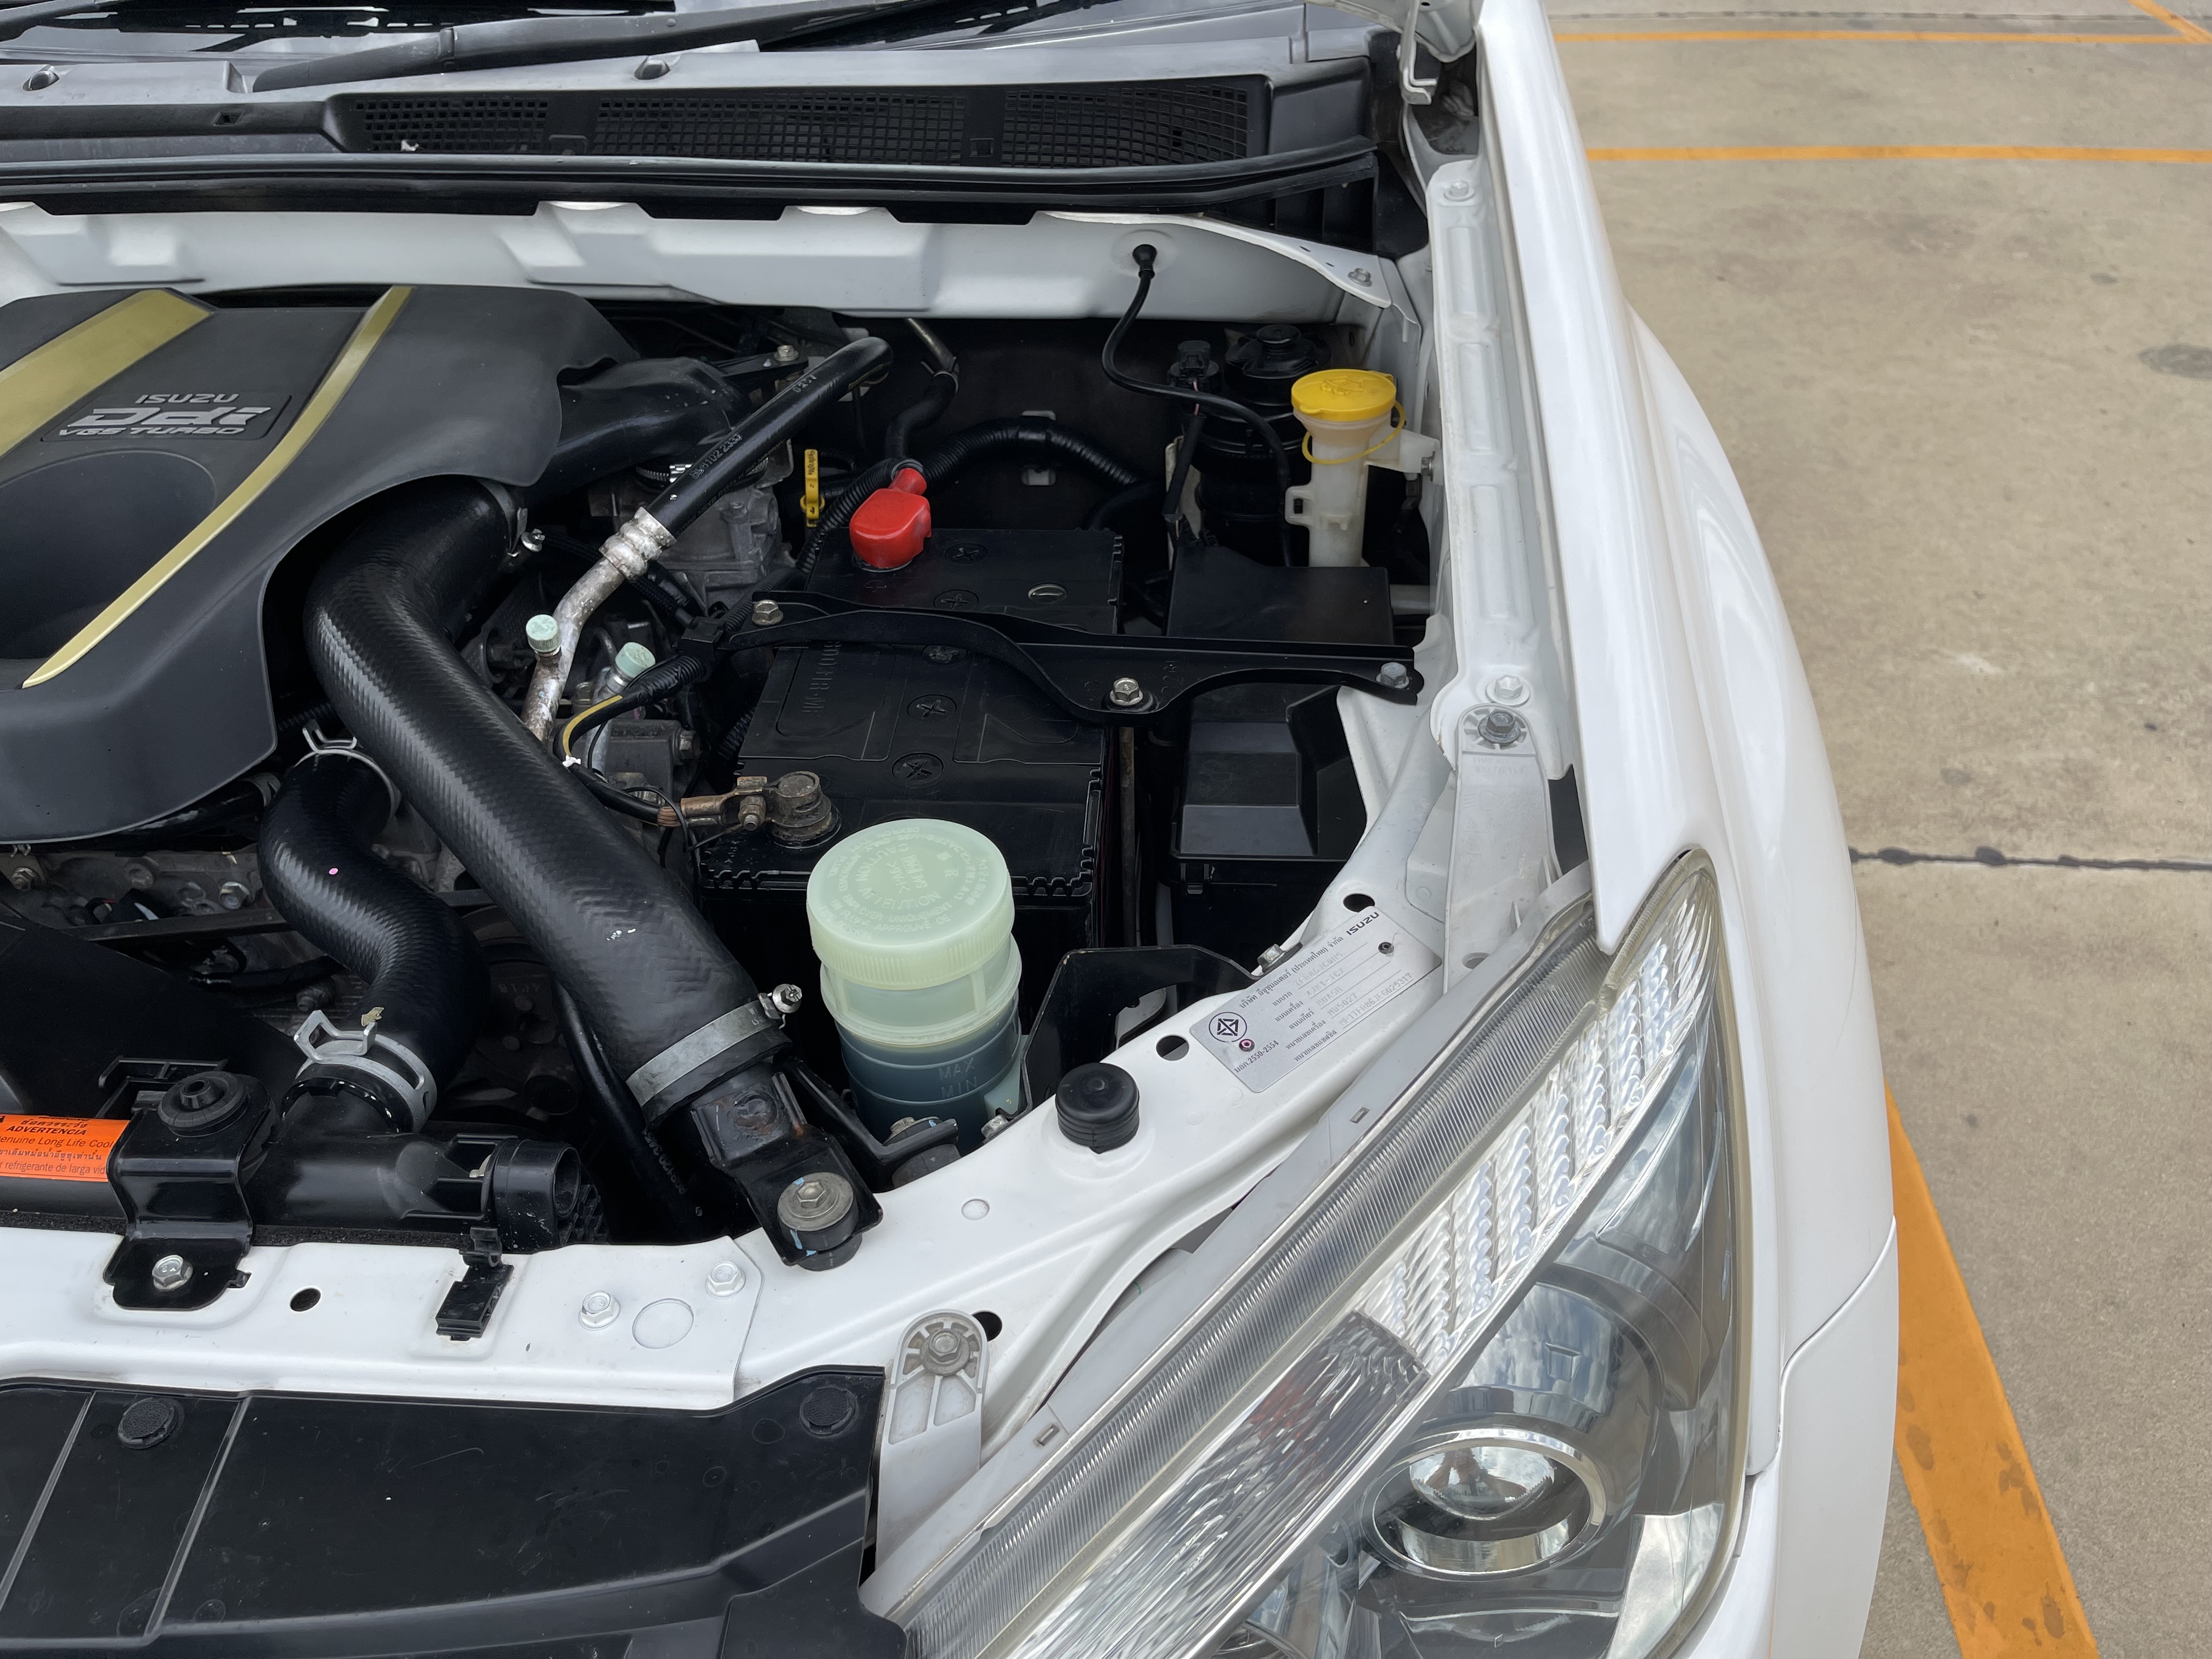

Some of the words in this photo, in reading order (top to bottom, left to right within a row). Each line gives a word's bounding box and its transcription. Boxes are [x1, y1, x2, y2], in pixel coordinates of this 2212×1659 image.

[135, 394, 239, 404] ISUZU
[59, 427, 127, 436] VGS
[130, 427, 245, 435] TURBO
[855, 843, 909, 882] CAUTION
[842, 894, 883, 921] EMPLOYER
[889, 901, 952, 922] UNIQUEMENT
[858, 887, 942, 910] ATTENTION
[935, 914, 951, 924] DE
[1346, 911, 1379, 936] ISUZU
[1239, 994, 1257, 1008] บริษัท
[1257, 969, 1291, 997] อีซูซุมอเตอร์
[1291, 947, 1329, 974] (ประเทศไทย)
[1328, 936, 1344, 949] จำกัด
[1272, 991, 1293, 1007] แบบรถ
[1275, 1000, 1304, 1022] แบบเครื่อง
[1285, 1020, 1326, 1049] หมายเลขเครื่อง
[1327, 993, 1358, 1016] MB5027
[1288, 1009, 1315, 1030] แบบเกียร์
[1234, 1040, 1279, 1073] มอก.2550-2554
[1294, 1030, 1338, 1062] หมายเลขแชสซิส
[939, 1057, 975, 1080] MAX
[941, 1076, 977, 1098] MIN
[0, 1135, 36, 1144] enuine
[38, 1137, 65, 1148] Long
[66, 1138, 86, 1147] Life
[5, 1126, 87, 1135] ADVERTENCIA
[5, 1160, 53, 1172] refrigerante
[56, 1164, 66, 1172] de
[69, 1164, 91, 1175] larga
